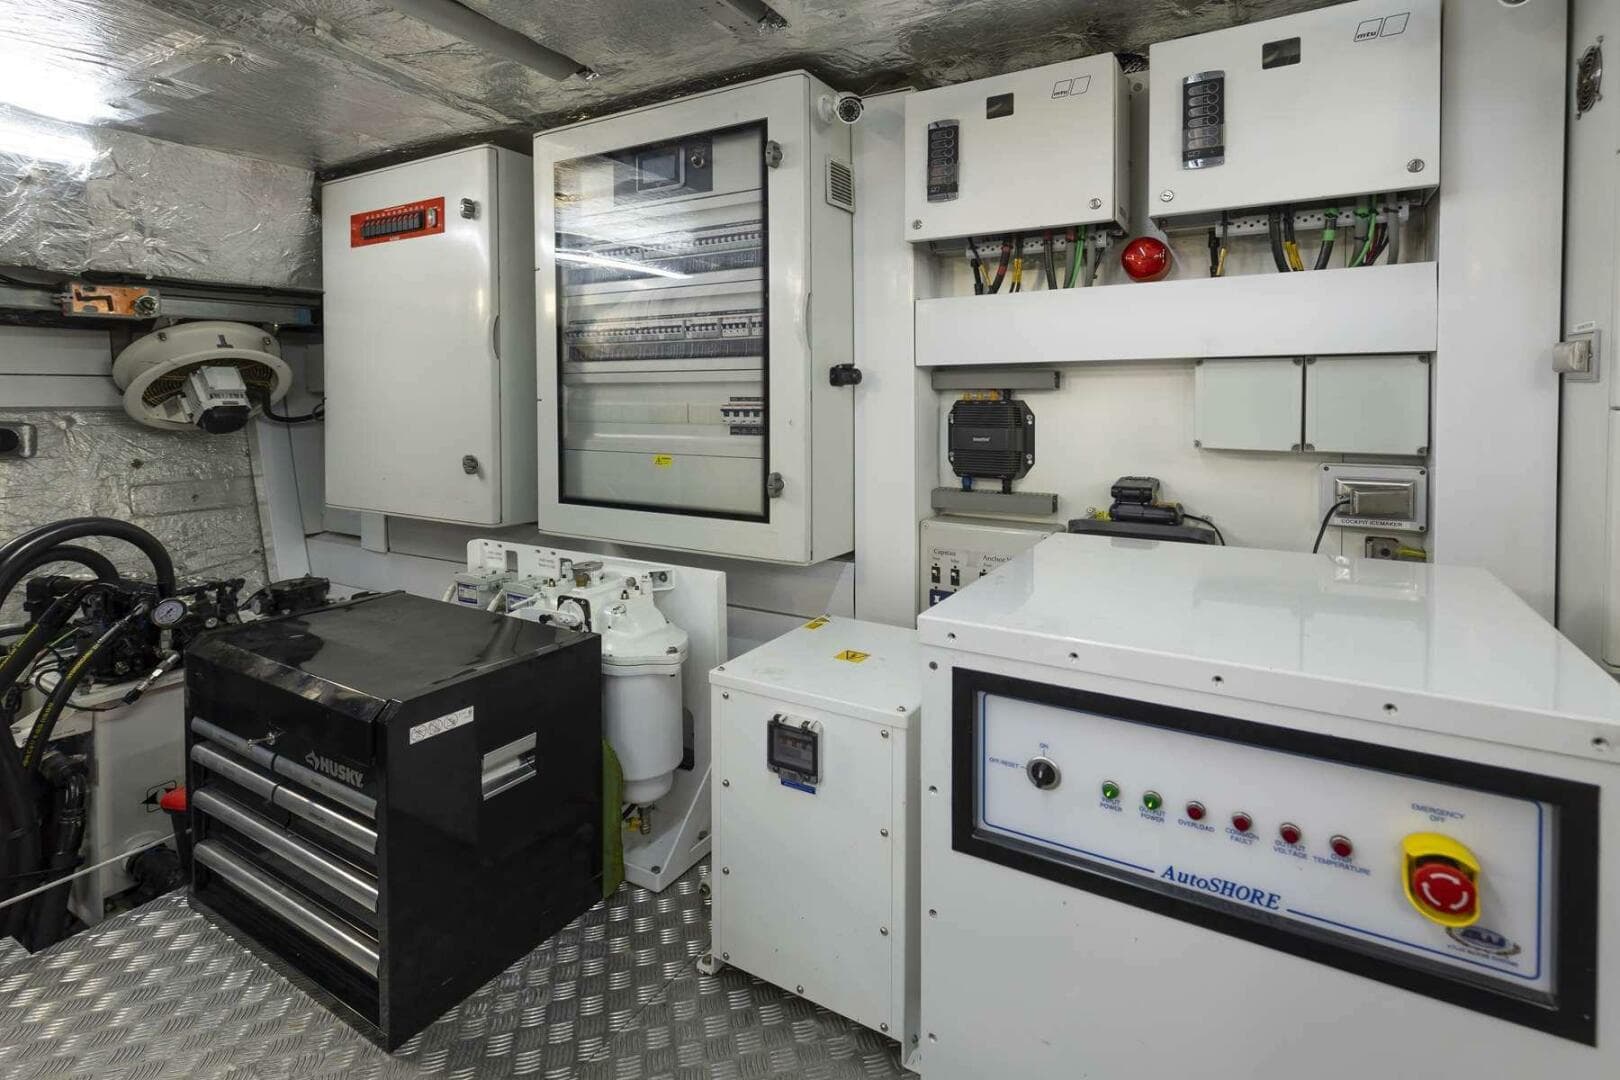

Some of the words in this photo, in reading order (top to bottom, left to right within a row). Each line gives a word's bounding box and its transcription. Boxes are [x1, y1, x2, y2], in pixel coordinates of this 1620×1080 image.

[1357, 31, 1376, 39] mtu
[1341, 518, 1368, 526] COCKPIT
[1369, 519, 1403, 528] ICEMAKER
[319, 755, 364, 789] HUSKY
[1099, 802, 1123, 813] POWER
[1139, 805, 1166, 817] OUTPUT
[1411, 803, 1465, 820] EMERGENCY
[1140, 813, 1165, 824] POWER
[1178, 818, 1216, 833] OVERLOAD
[1225, 826, 1260, 841] COMMON
[1230, 834, 1253, 846] FAULT
[1273, 846, 1308, 860] VOLTAGE
[1274, 839, 1306, 853] OUTPUT
[1313, 856, 1372, 876] TEMPERATURE
[1160, 865, 1282, 911] AutoSHORE
